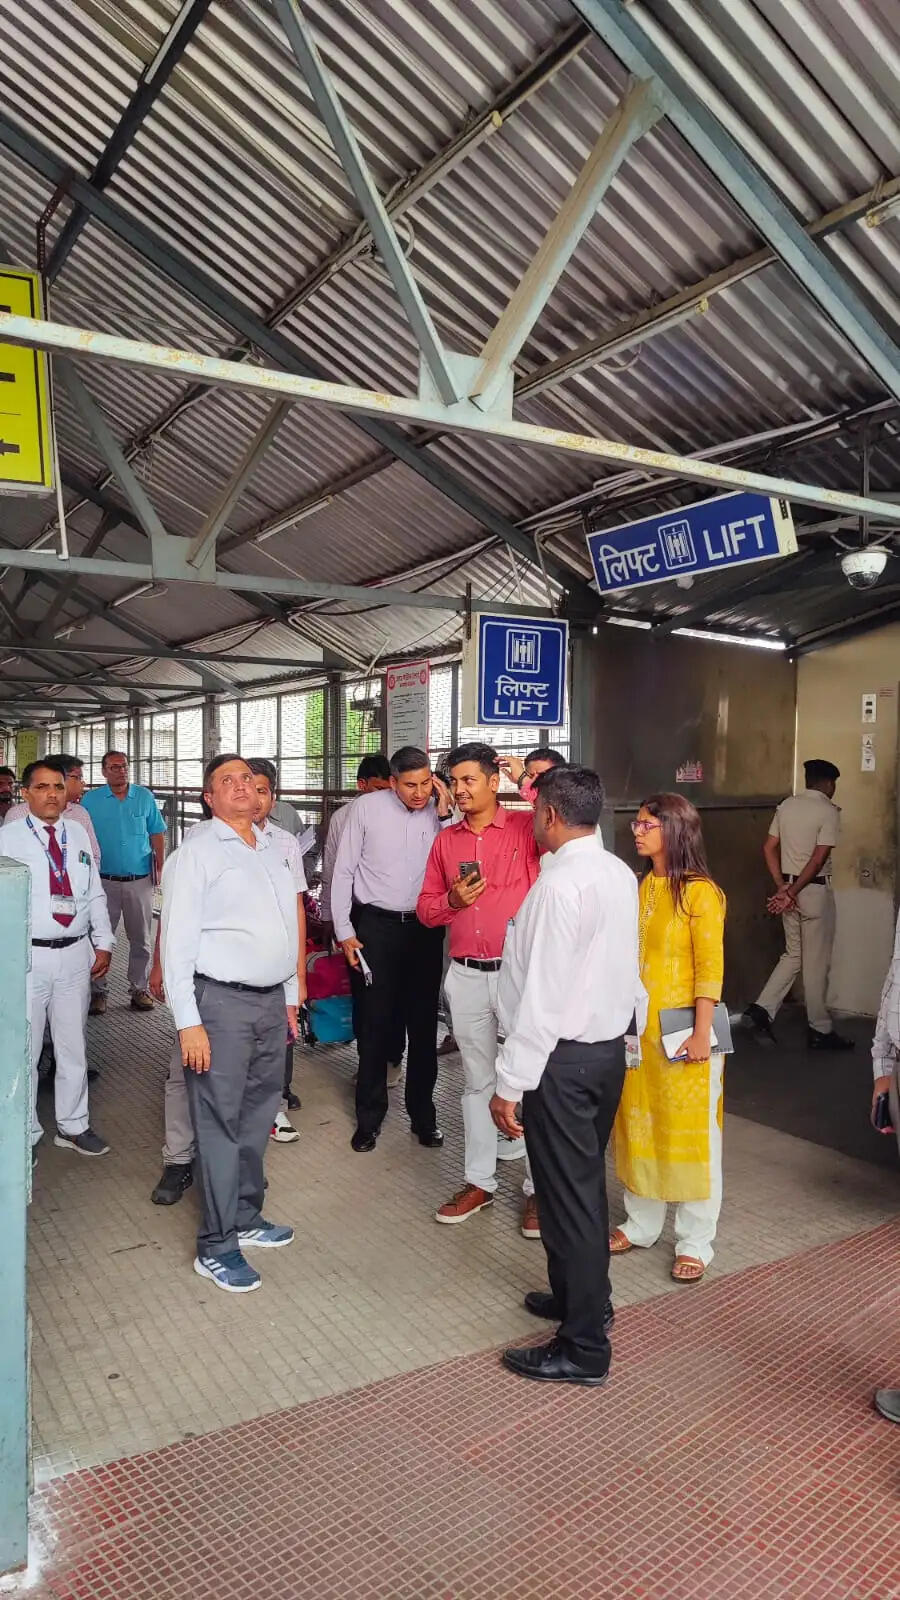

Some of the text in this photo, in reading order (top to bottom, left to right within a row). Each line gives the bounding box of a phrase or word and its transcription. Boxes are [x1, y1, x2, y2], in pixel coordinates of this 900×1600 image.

[599, 514, 766, 585] लिफ्ट LIFT
[494, 675, 550, 698] लिफ्ट
[493, 699, 549, 717] LIFT
